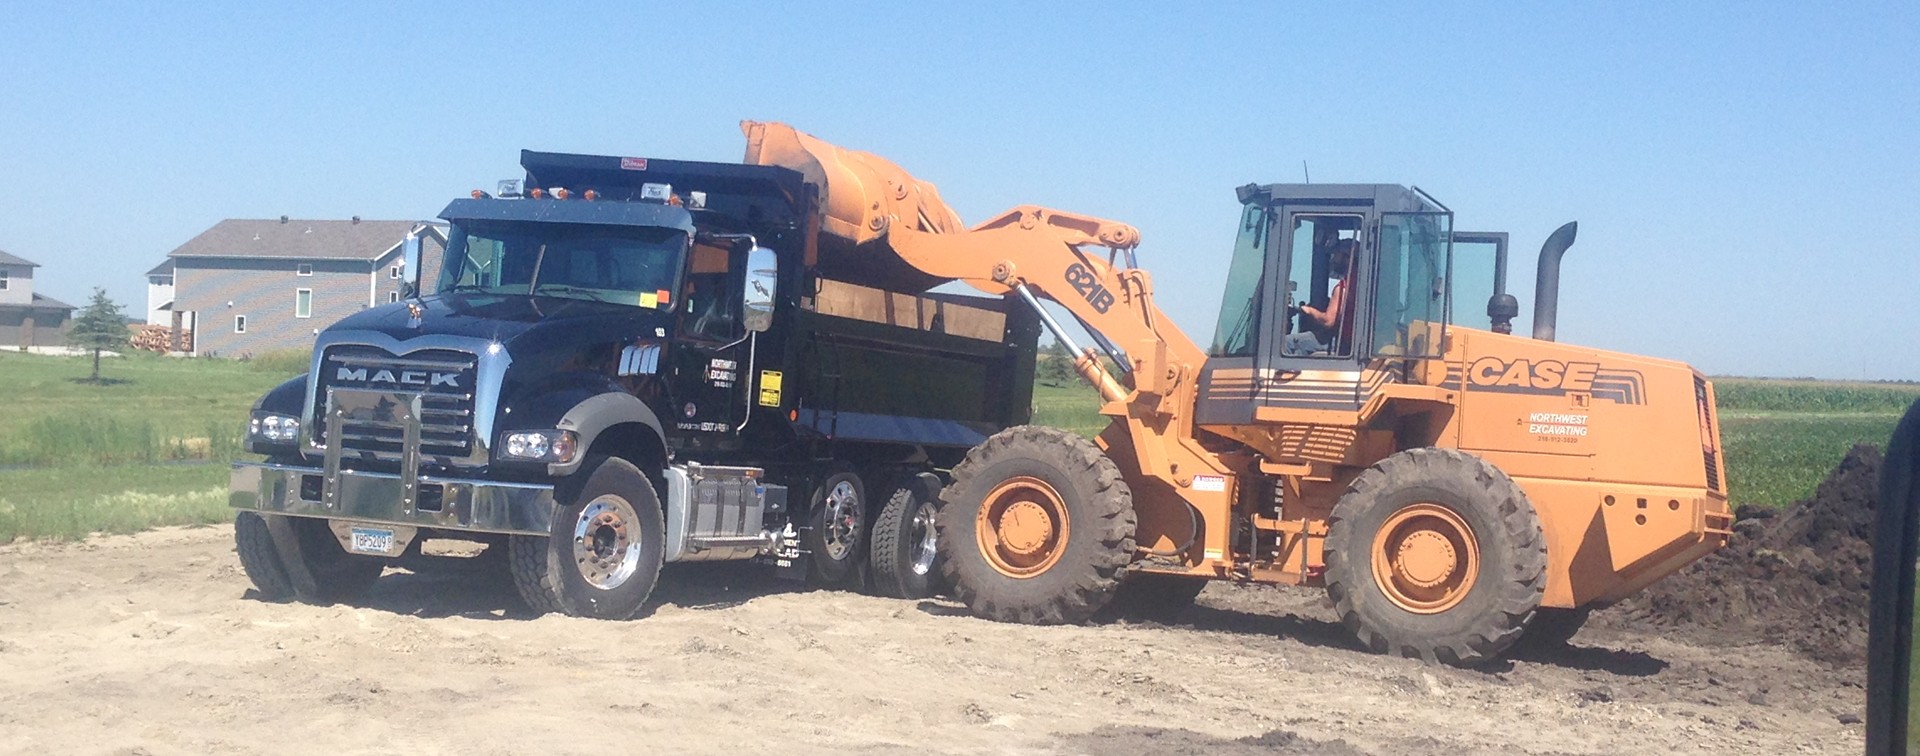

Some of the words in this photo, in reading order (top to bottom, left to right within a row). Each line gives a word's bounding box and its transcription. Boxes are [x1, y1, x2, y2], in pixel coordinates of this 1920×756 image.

[1065, 262, 1115, 315] 621B
[337, 367, 460, 387] MACK
[1470, 356, 1600, 392] CASE
[1529, 412, 1588, 425] NORTHWEST
[1529, 424, 1588, 436] EXCAVATING
